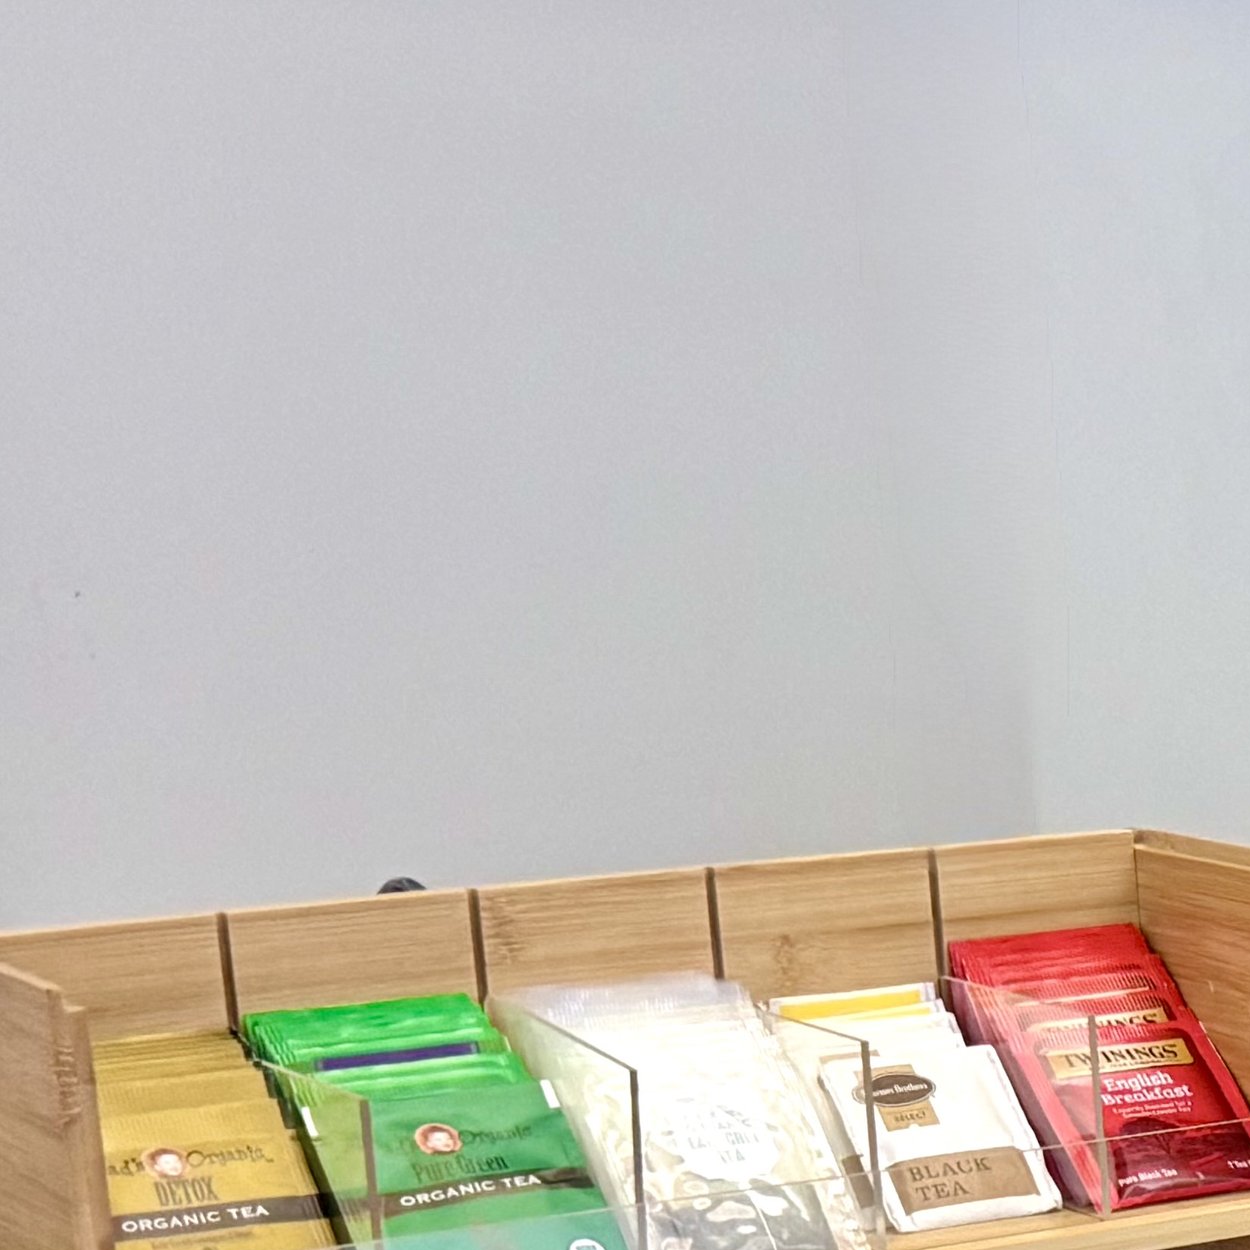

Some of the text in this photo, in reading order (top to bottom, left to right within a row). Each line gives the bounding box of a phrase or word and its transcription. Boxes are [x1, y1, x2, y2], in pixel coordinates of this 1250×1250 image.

[1063, 1043, 1178, 1068] TWININGS
[1103, 1071, 1173, 1092] English
[1101, 1084, 1193, 1106] Breakfast
[908, 1156, 992, 1182] BLACK
[153, 1176, 219, 1207] DETOX
[400, 1173, 542, 1207] ORGANIC TEA
[915, 1180, 970, 1201] TEA
[121, 1204, 270, 1233] ORGANIC TEA
